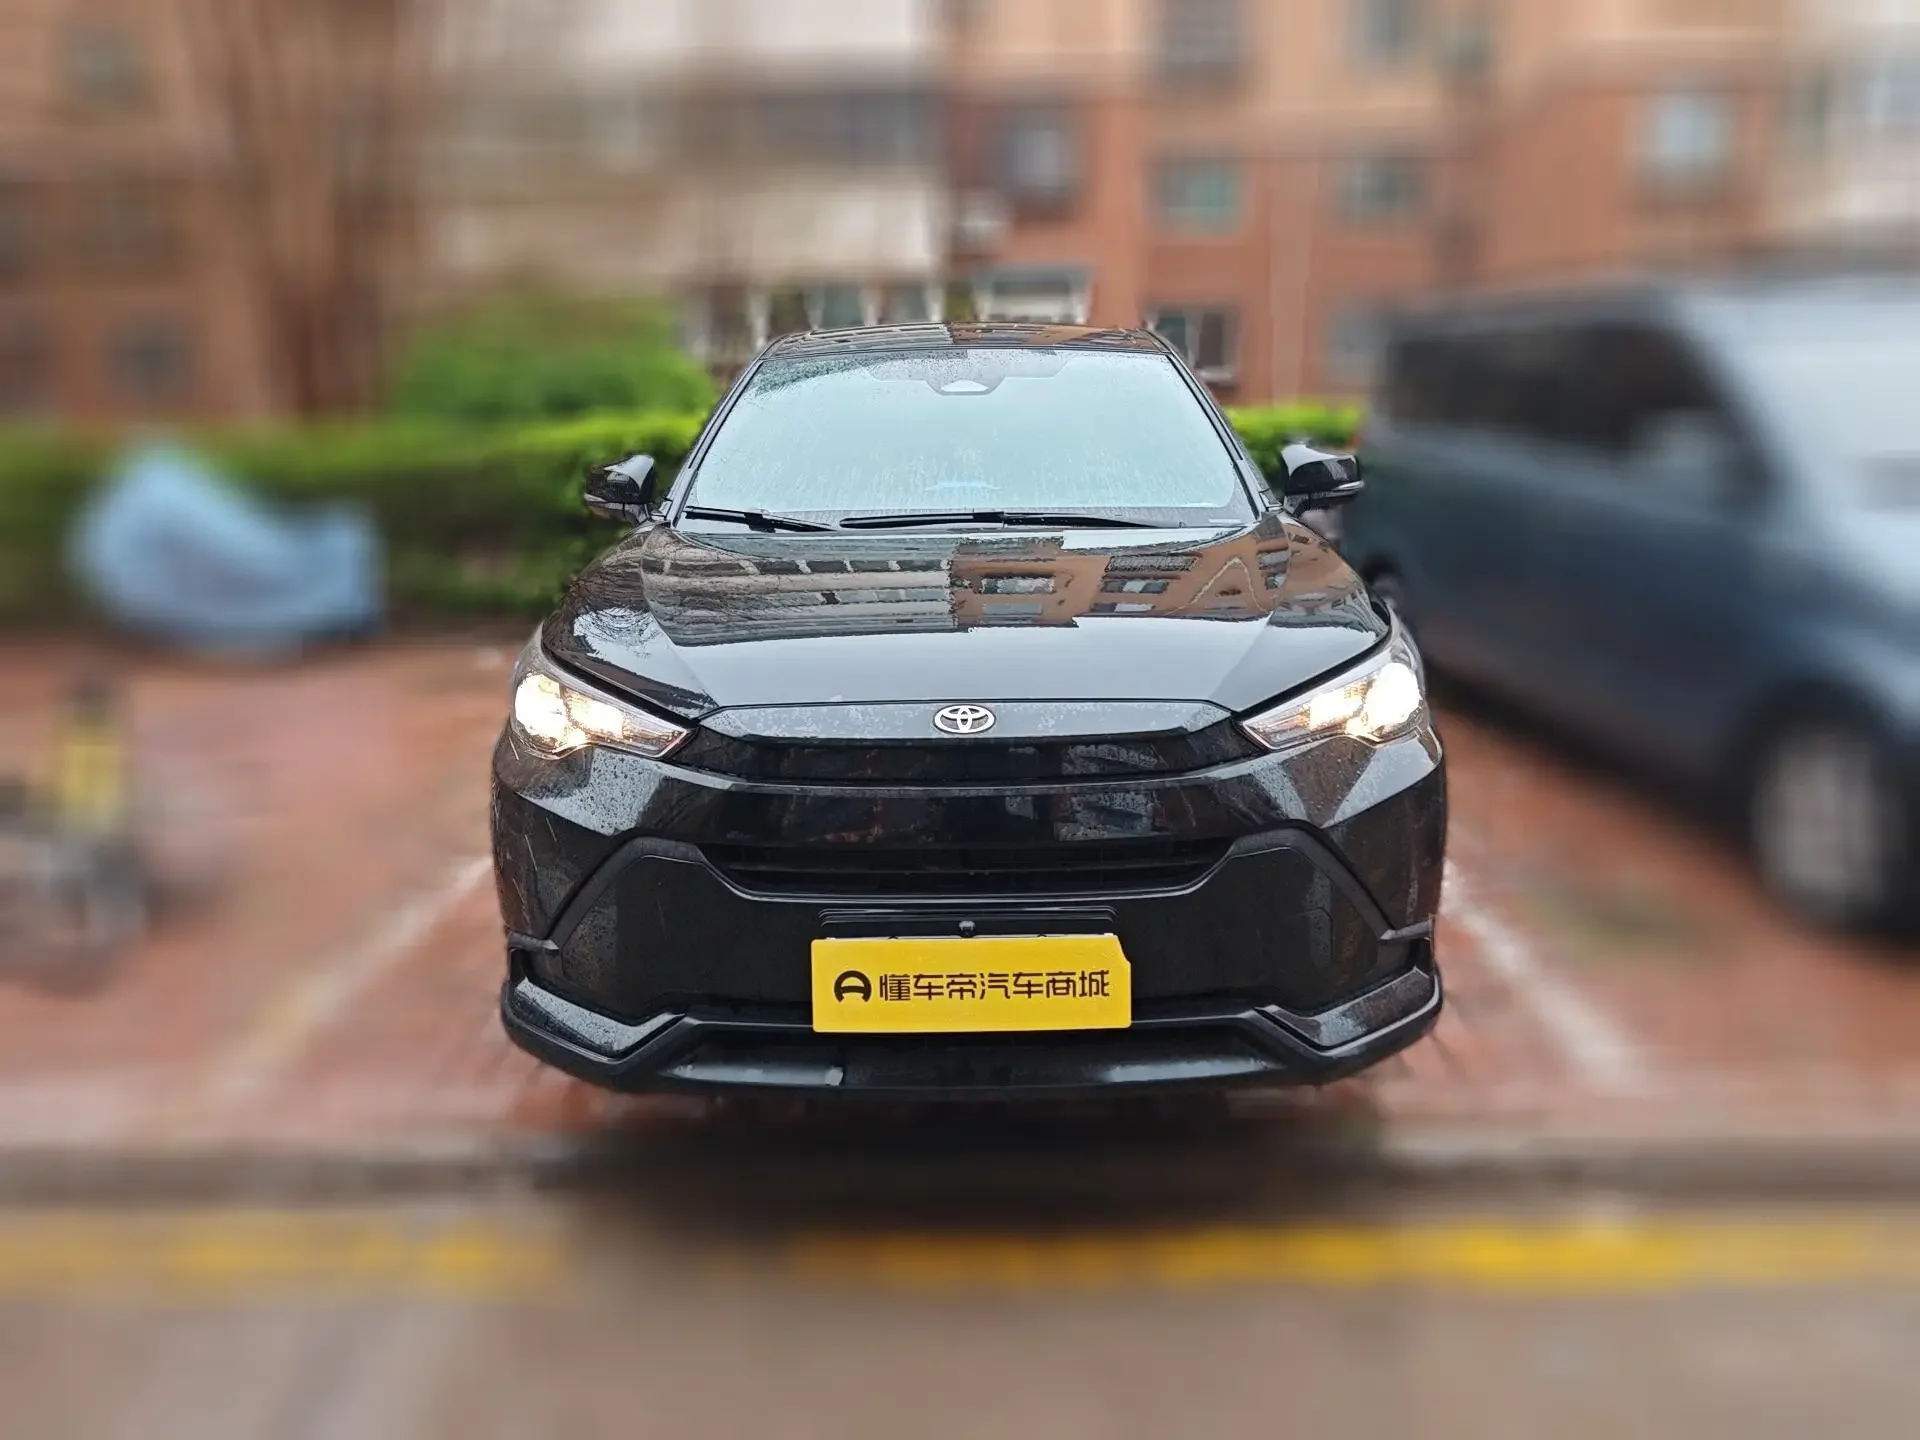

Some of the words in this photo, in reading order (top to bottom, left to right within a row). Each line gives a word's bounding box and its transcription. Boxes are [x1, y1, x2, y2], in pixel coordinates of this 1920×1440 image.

[879, 970, 1110, 1001] 懂车帝汽车商城
